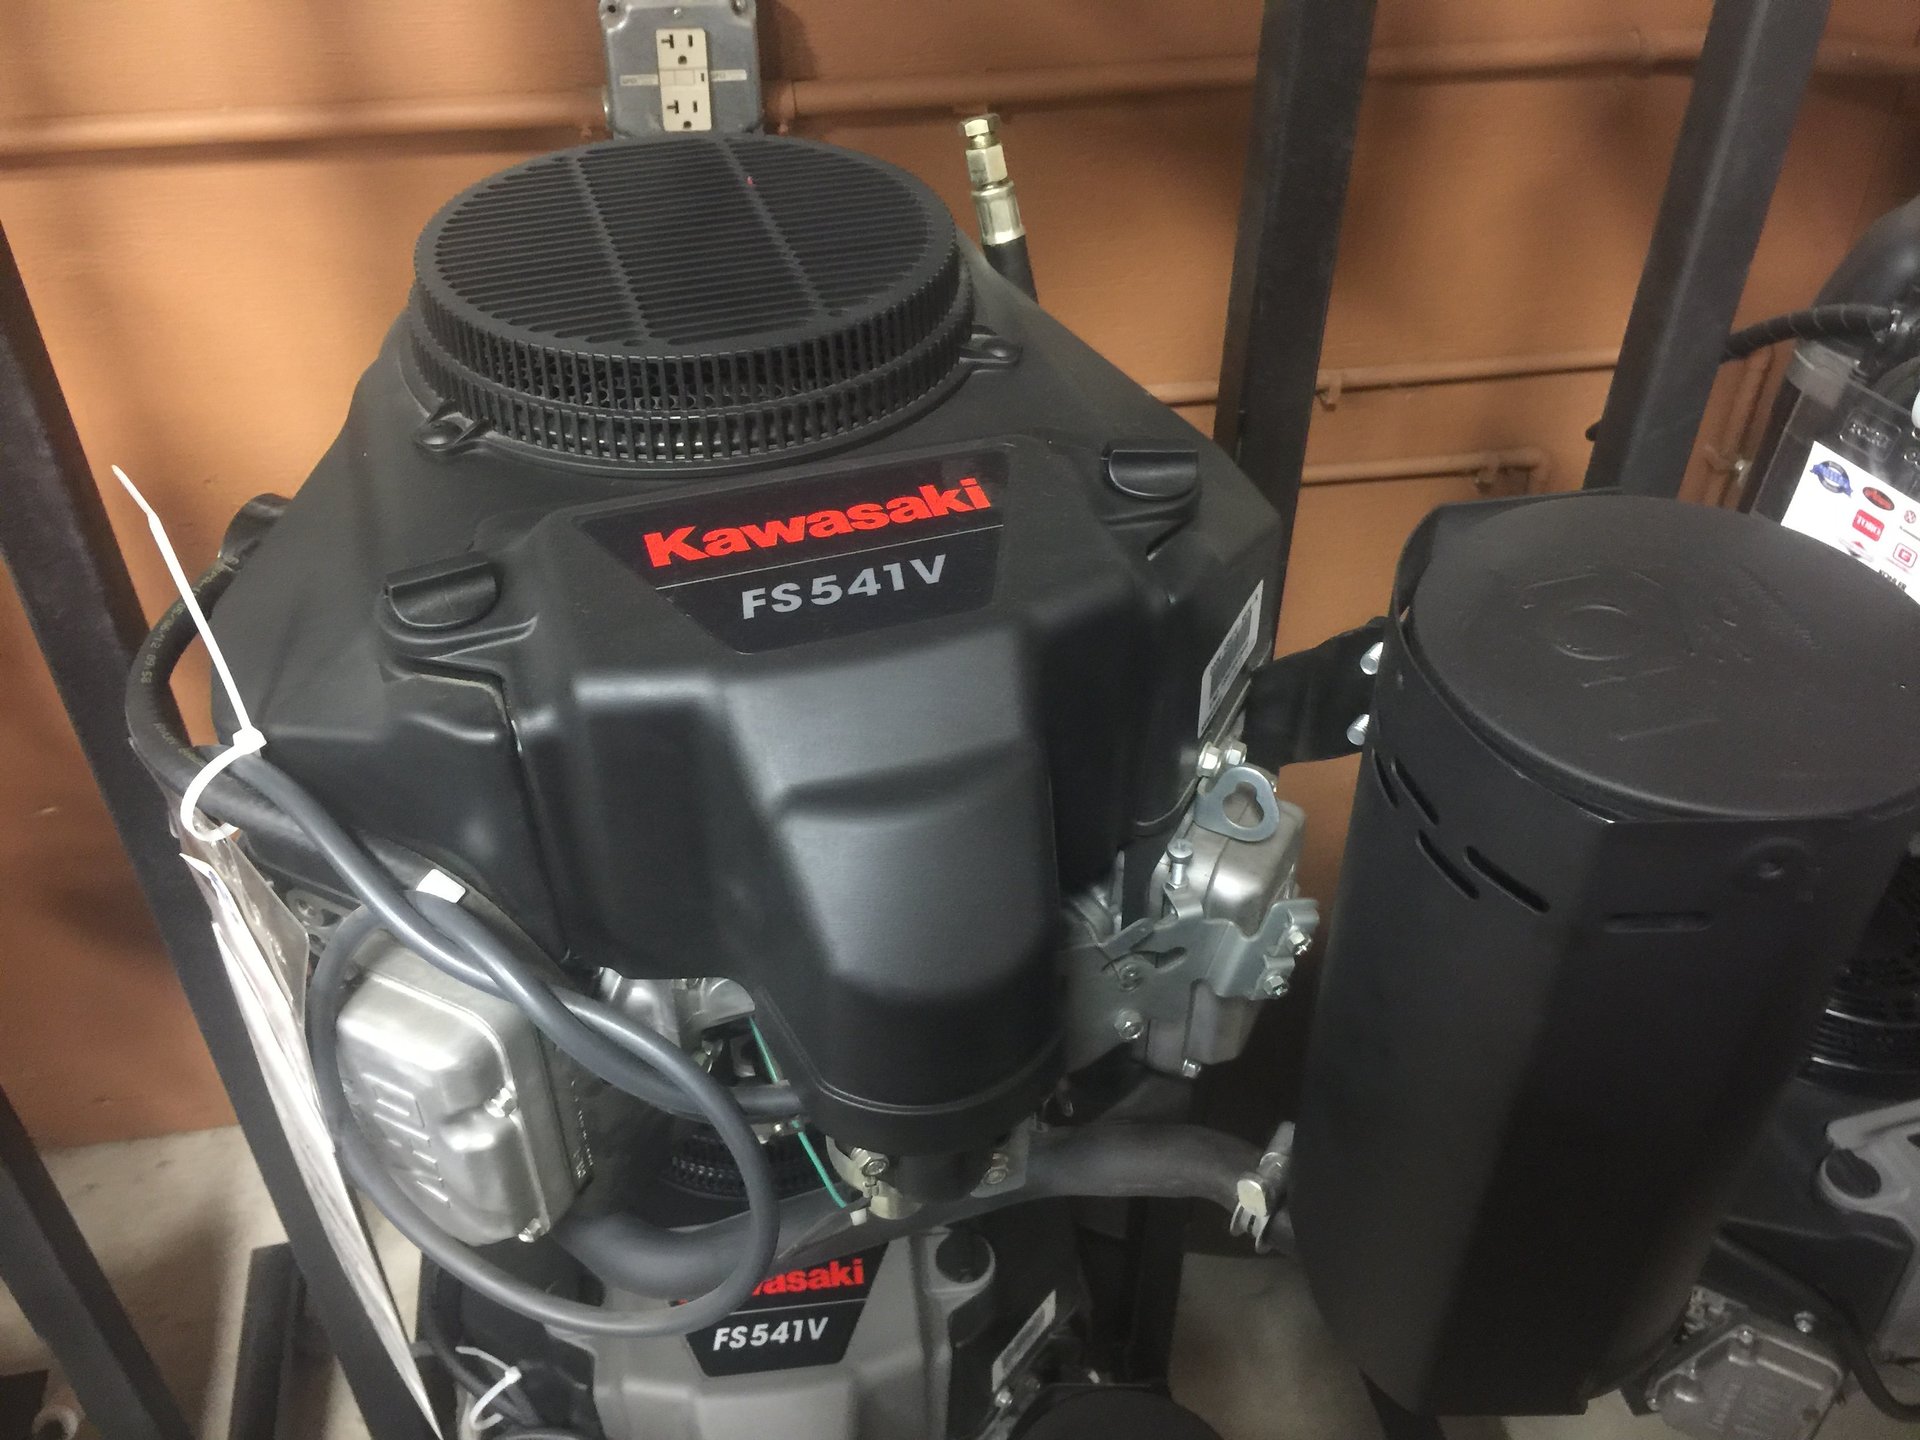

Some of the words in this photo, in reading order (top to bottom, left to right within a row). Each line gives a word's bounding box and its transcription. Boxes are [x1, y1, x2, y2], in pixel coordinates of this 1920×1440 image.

[643, 477, 992, 568] Kawasaki
[741, 554, 946, 620] FS541V
[712, 1317, 829, 1351] FS541V
